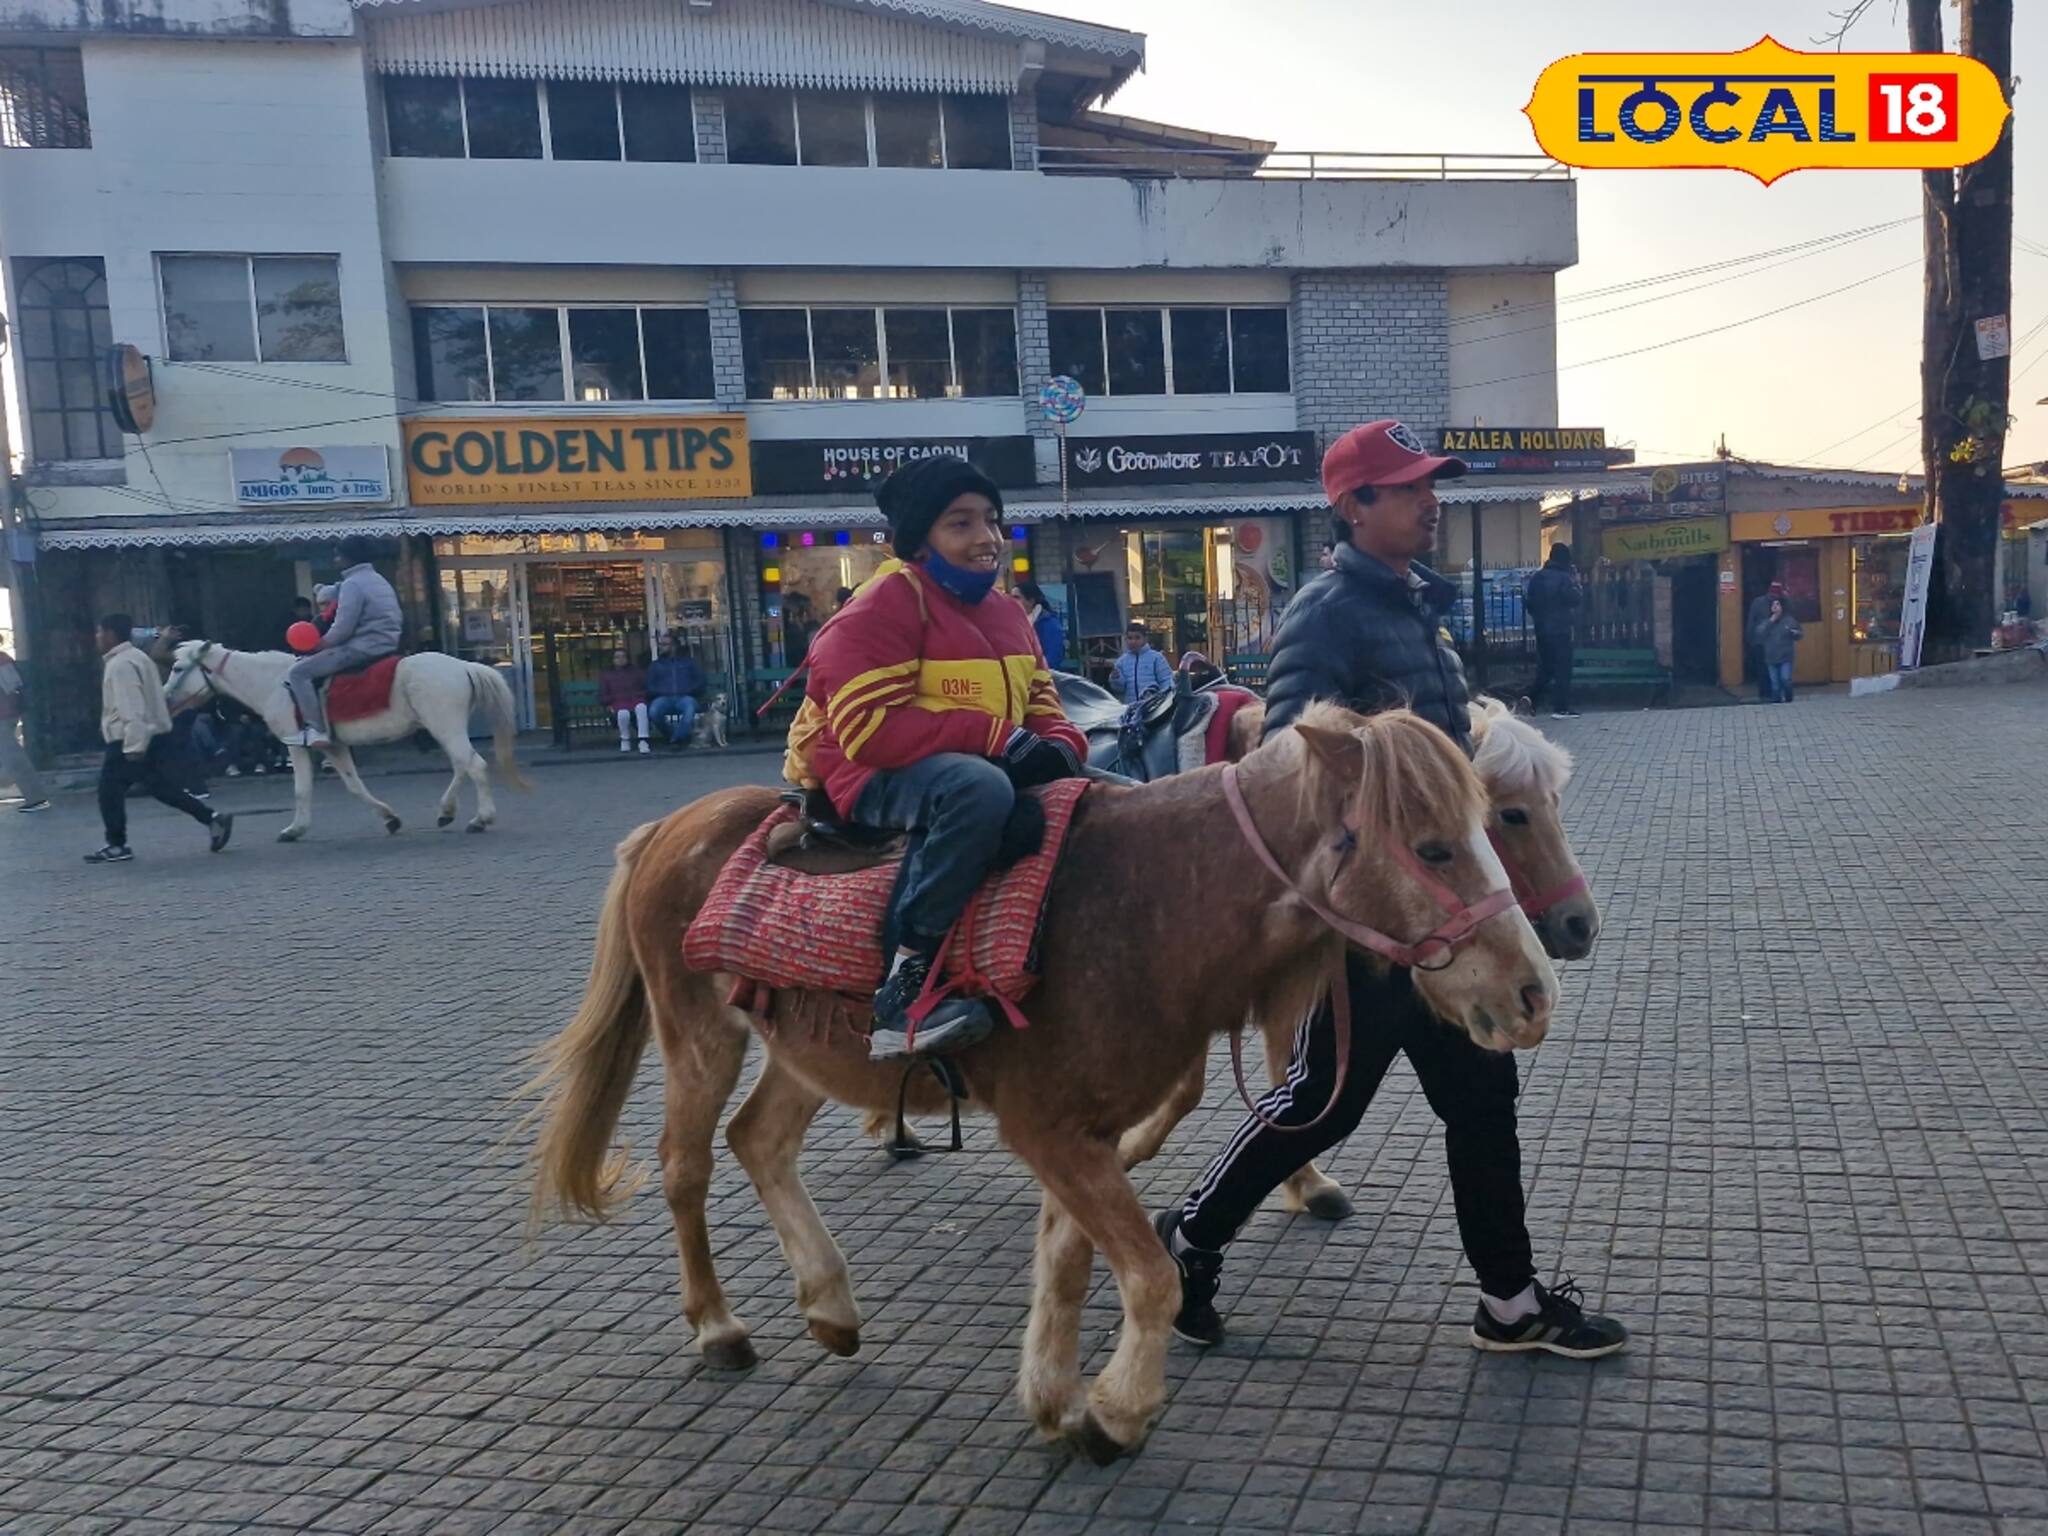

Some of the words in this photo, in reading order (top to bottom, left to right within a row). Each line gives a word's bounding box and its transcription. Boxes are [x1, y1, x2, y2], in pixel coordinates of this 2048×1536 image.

[1443, 431, 1514, 450] AZALEA
[1520, 431, 1604, 449] HOLIDAYS
[411, 429, 626, 476] GOLDEN
[632, 427, 735, 472] TIPS
[824, 447, 880, 462] HOUSE
[883, 446, 905, 460] OF
[1209, 442, 1302, 468] TEAPOT
[1680, 471, 1720, 484] BITES
[241, 484, 298, 498] AMIGOS
[307, 484, 335, 495] Tours
[342, 484, 350, 494] &
[354, 483, 382, 494] Treks
[424, 482, 509, 496] WORLD'S
[517, 480, 582, 493] FINEST
[592, 480, 636, 491] TEAS
[641, 479, 697, 489] SINCE
[1829, 509, 1919, 533] TIBET
